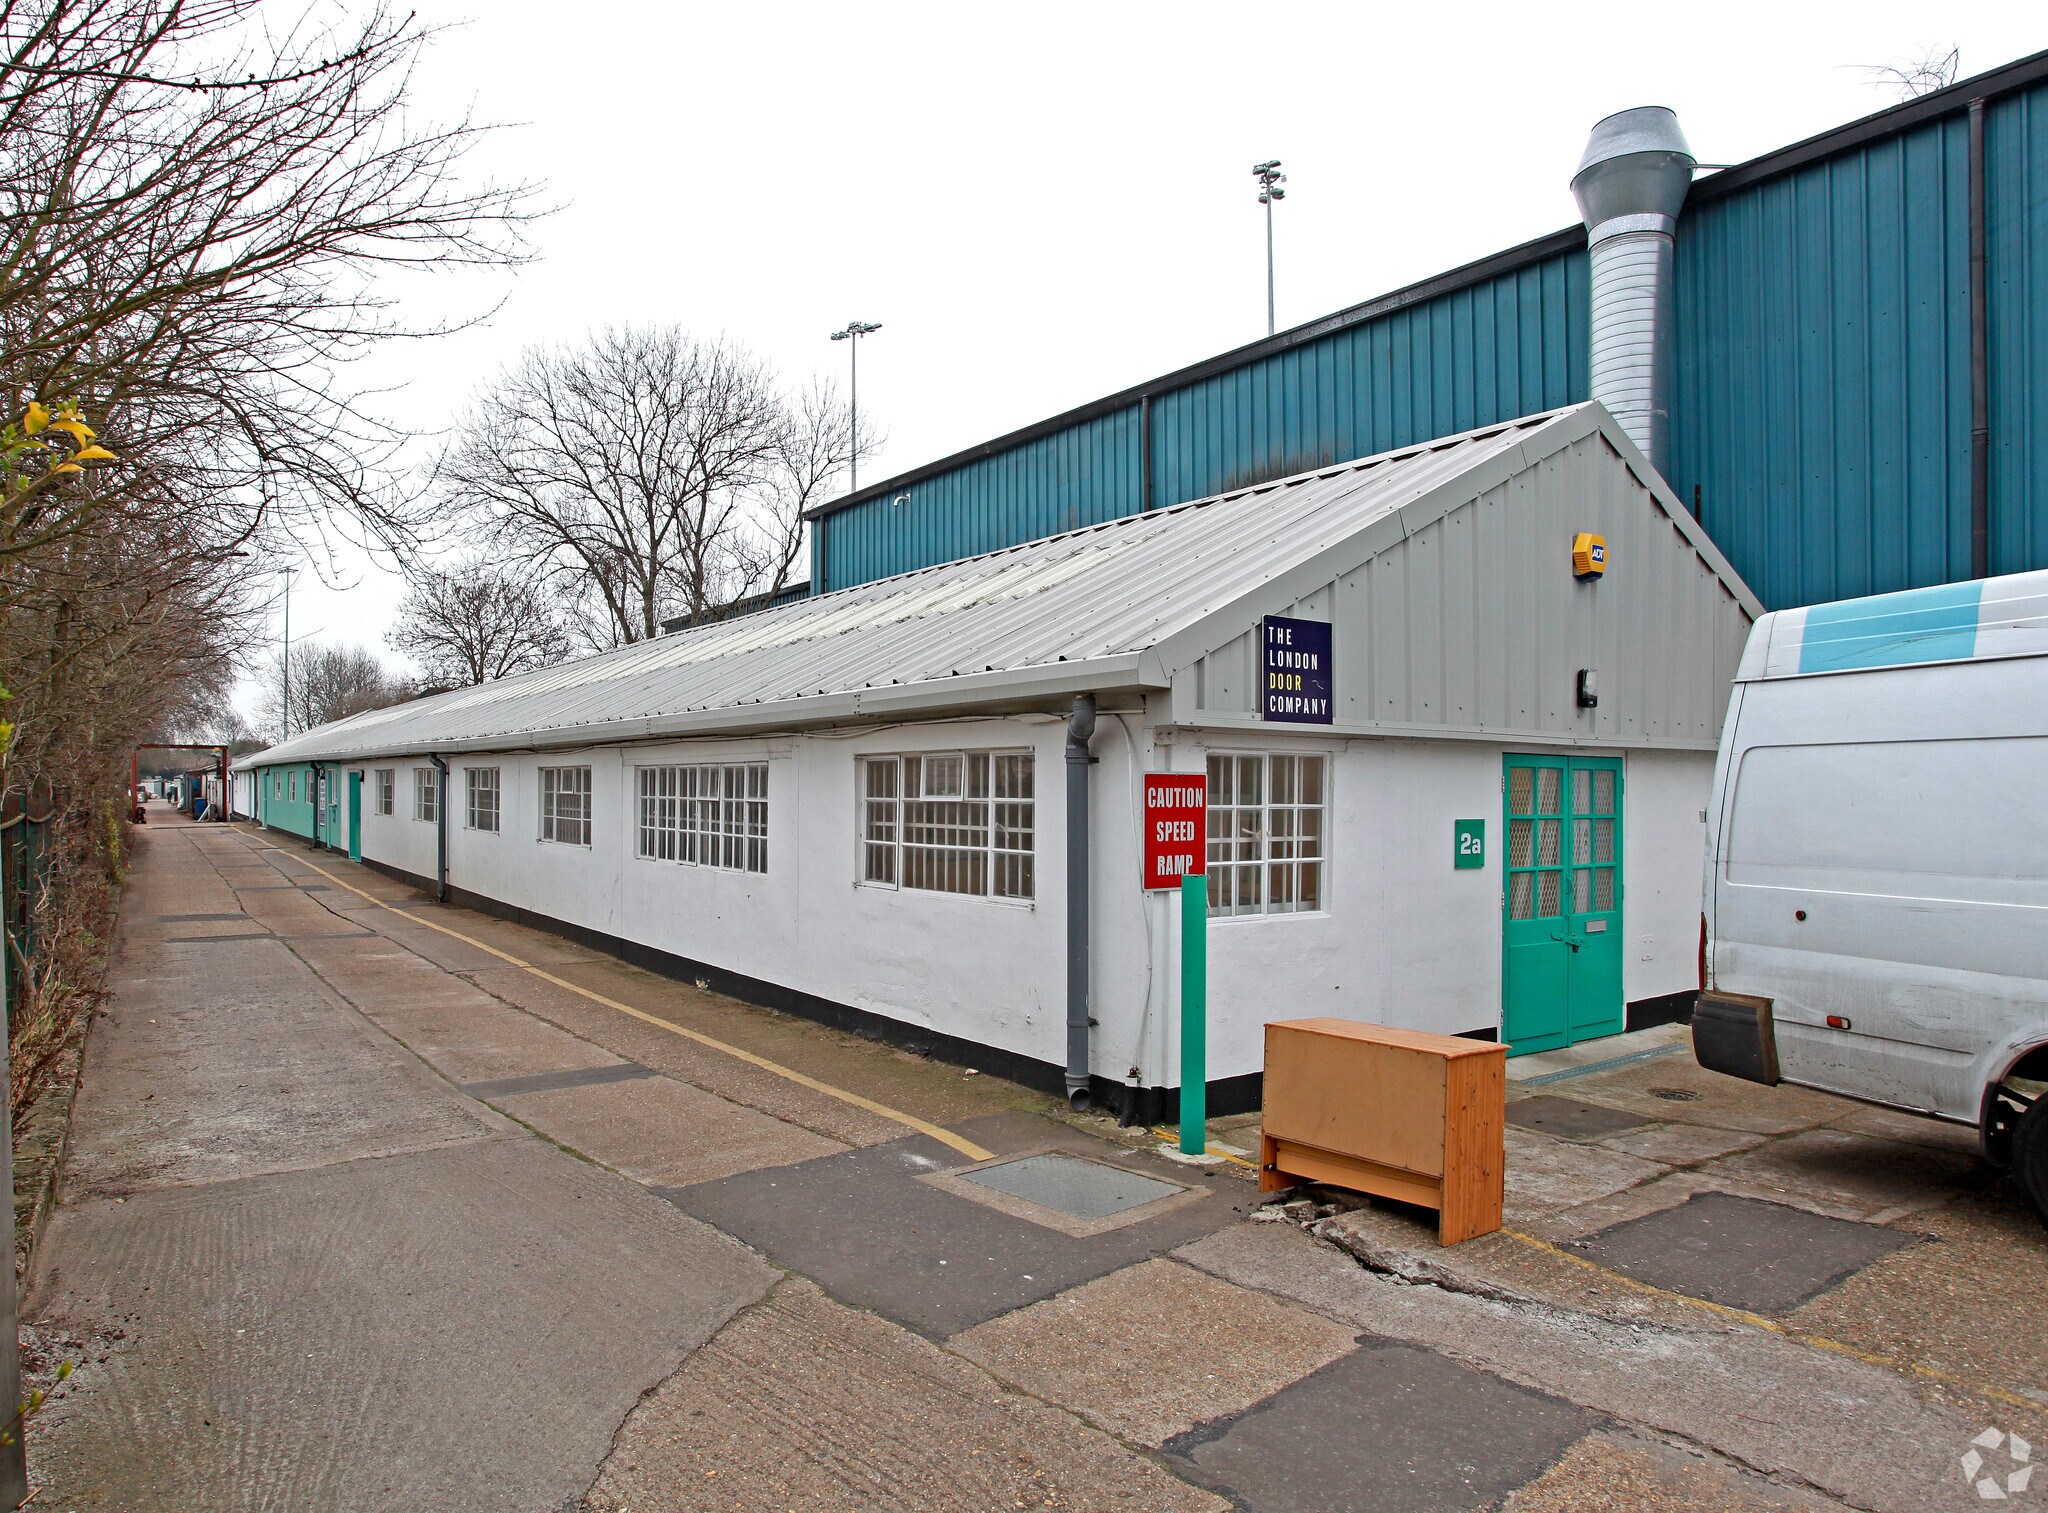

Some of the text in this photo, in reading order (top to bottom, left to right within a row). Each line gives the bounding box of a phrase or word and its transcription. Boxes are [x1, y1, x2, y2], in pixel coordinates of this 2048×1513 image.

[1592, 549, 1604, 560] ADT
[1268, 626, 1292, 645] THE
[1269, 649, 1318, 670] LONDON
[1269, 672, 1302, 691] DOOR
[1269, 695, 1327, 715] COMPANY
[1147, 787, 1203, 809] CAUTION
[1156, 821, 1195, 842] SPEED
[1460, 832, 1481, 855] 2a
[1157, 854, 1194, 876] RAMP
